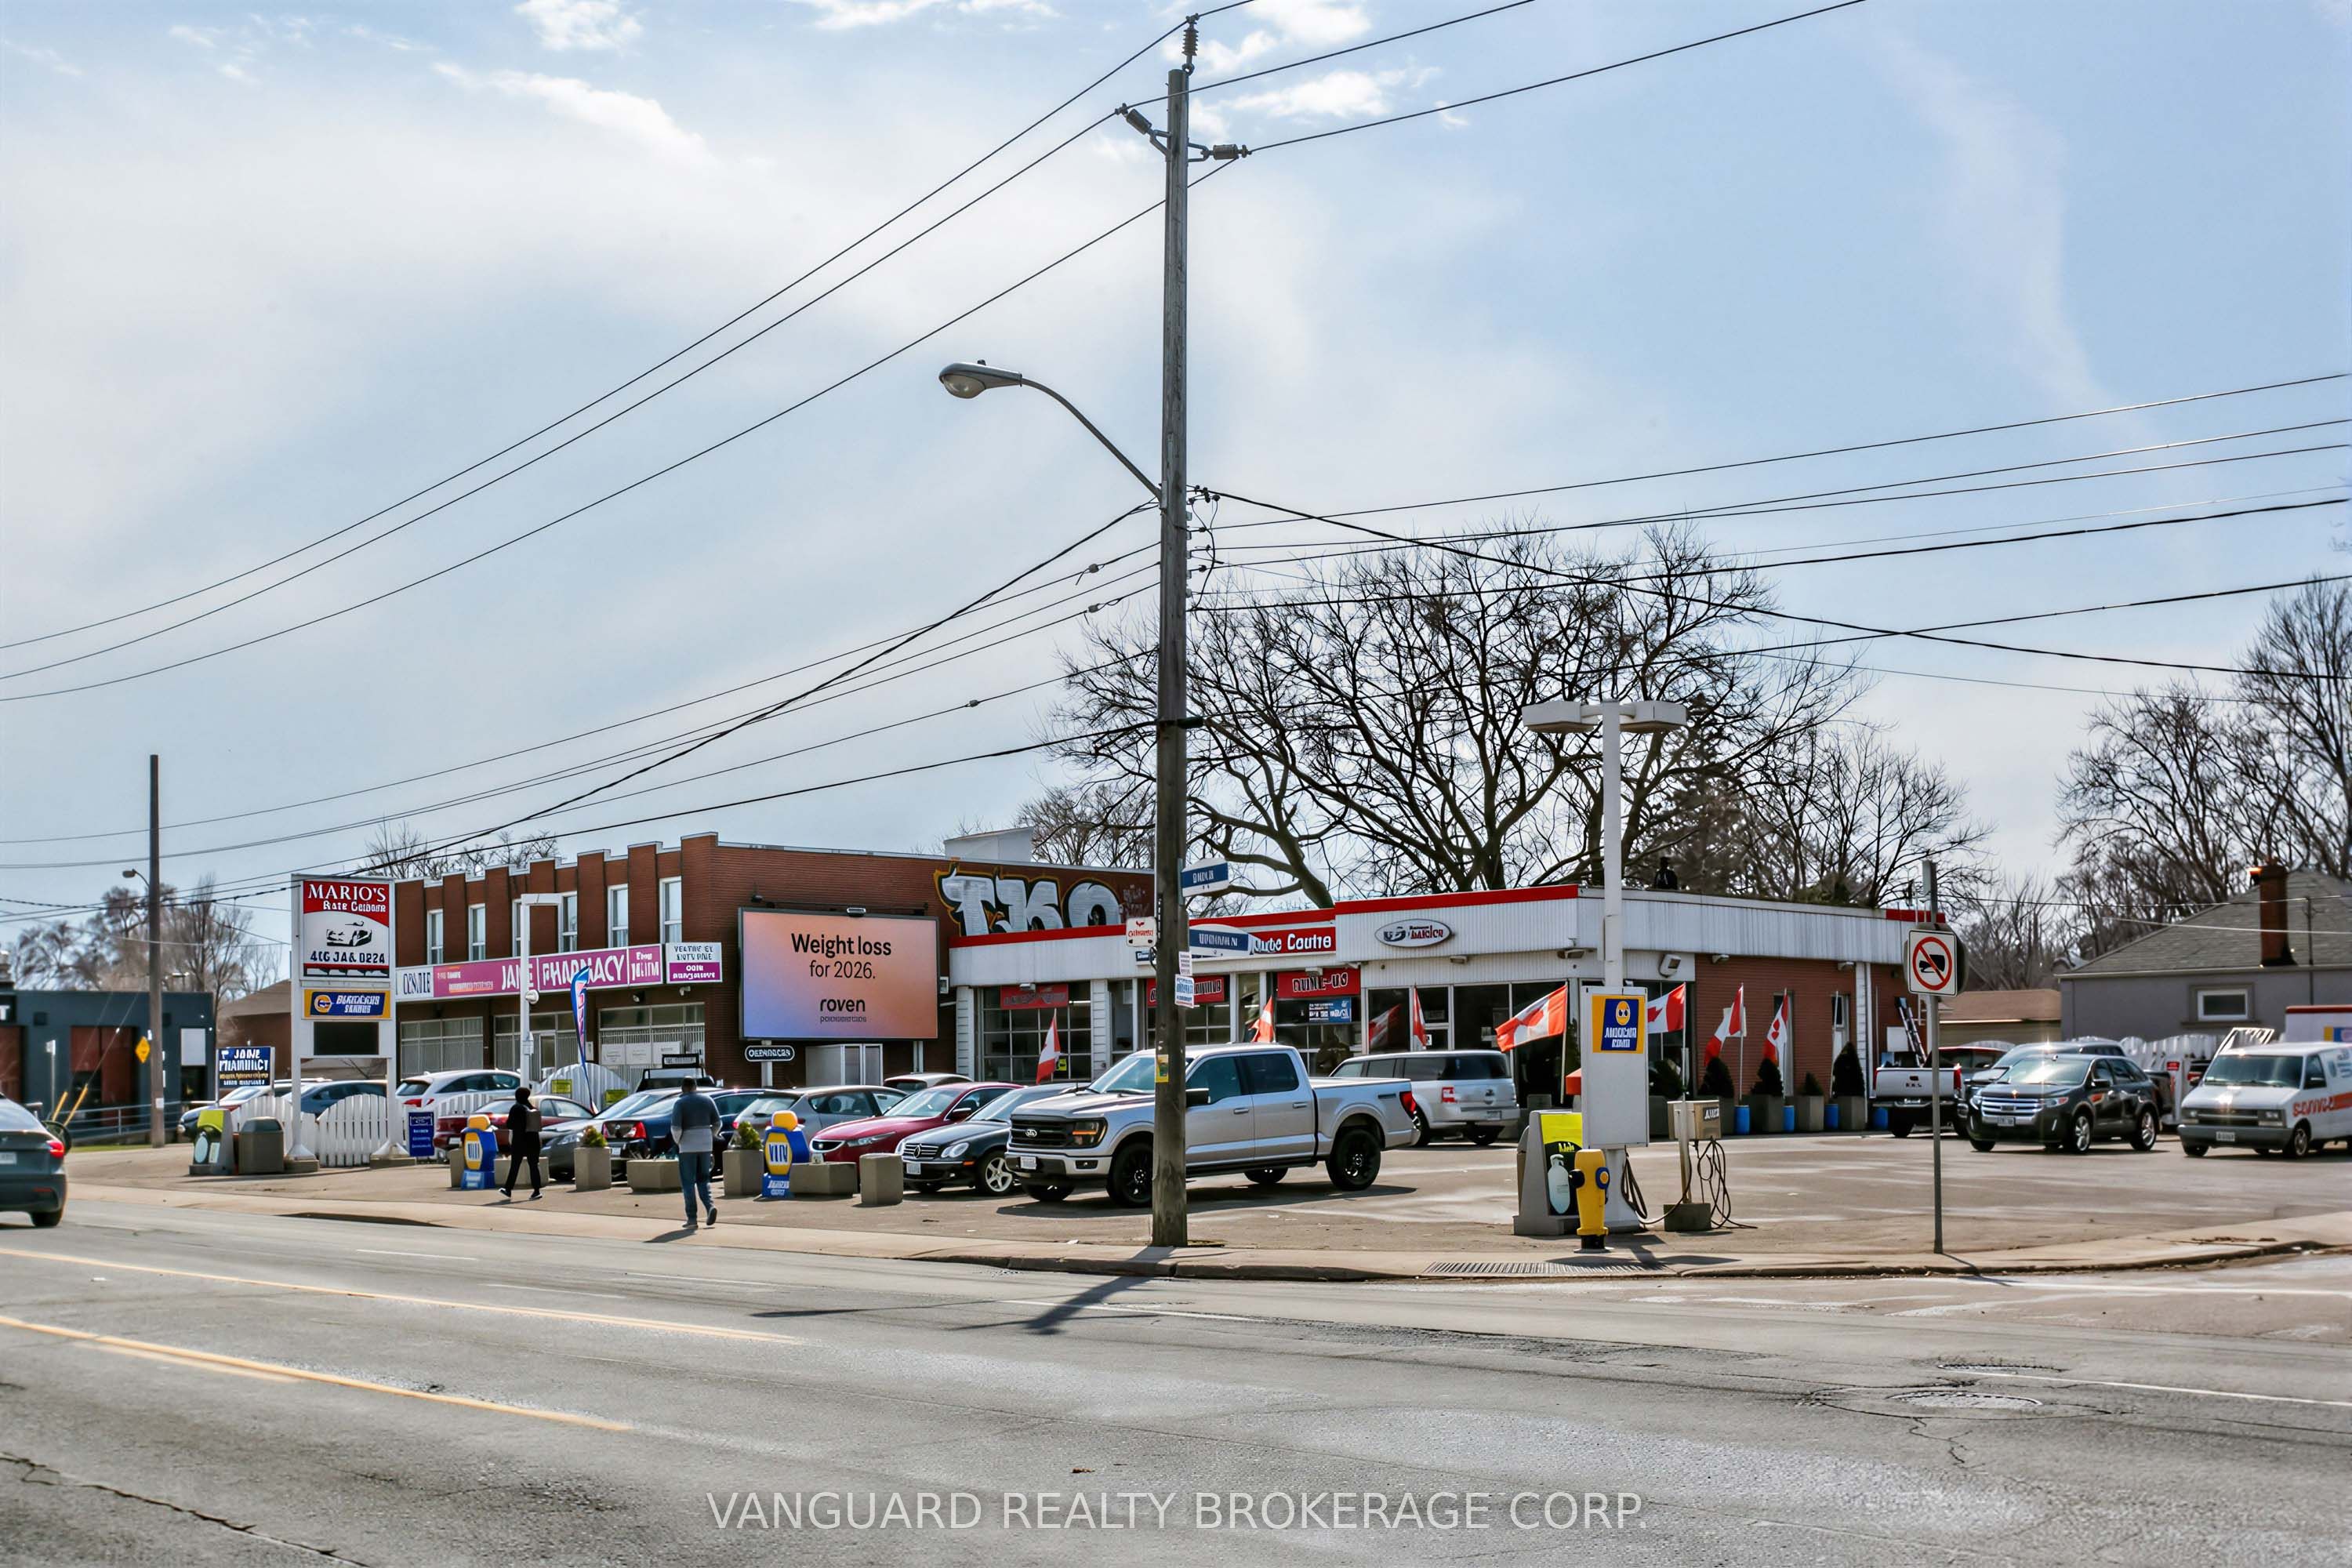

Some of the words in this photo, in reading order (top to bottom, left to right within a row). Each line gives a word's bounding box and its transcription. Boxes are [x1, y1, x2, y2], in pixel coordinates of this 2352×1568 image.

[308, 884, 387, 902] MARIO'S
[935, 859, 1125, 938] TKO
[791, 933, 855, 958] Weight
[858, 935, 891, 956] loss
[809, 960, 830, 978] for
[833, 960, 876, 979] 2026.
[819, 998, 866, 1012] roven
